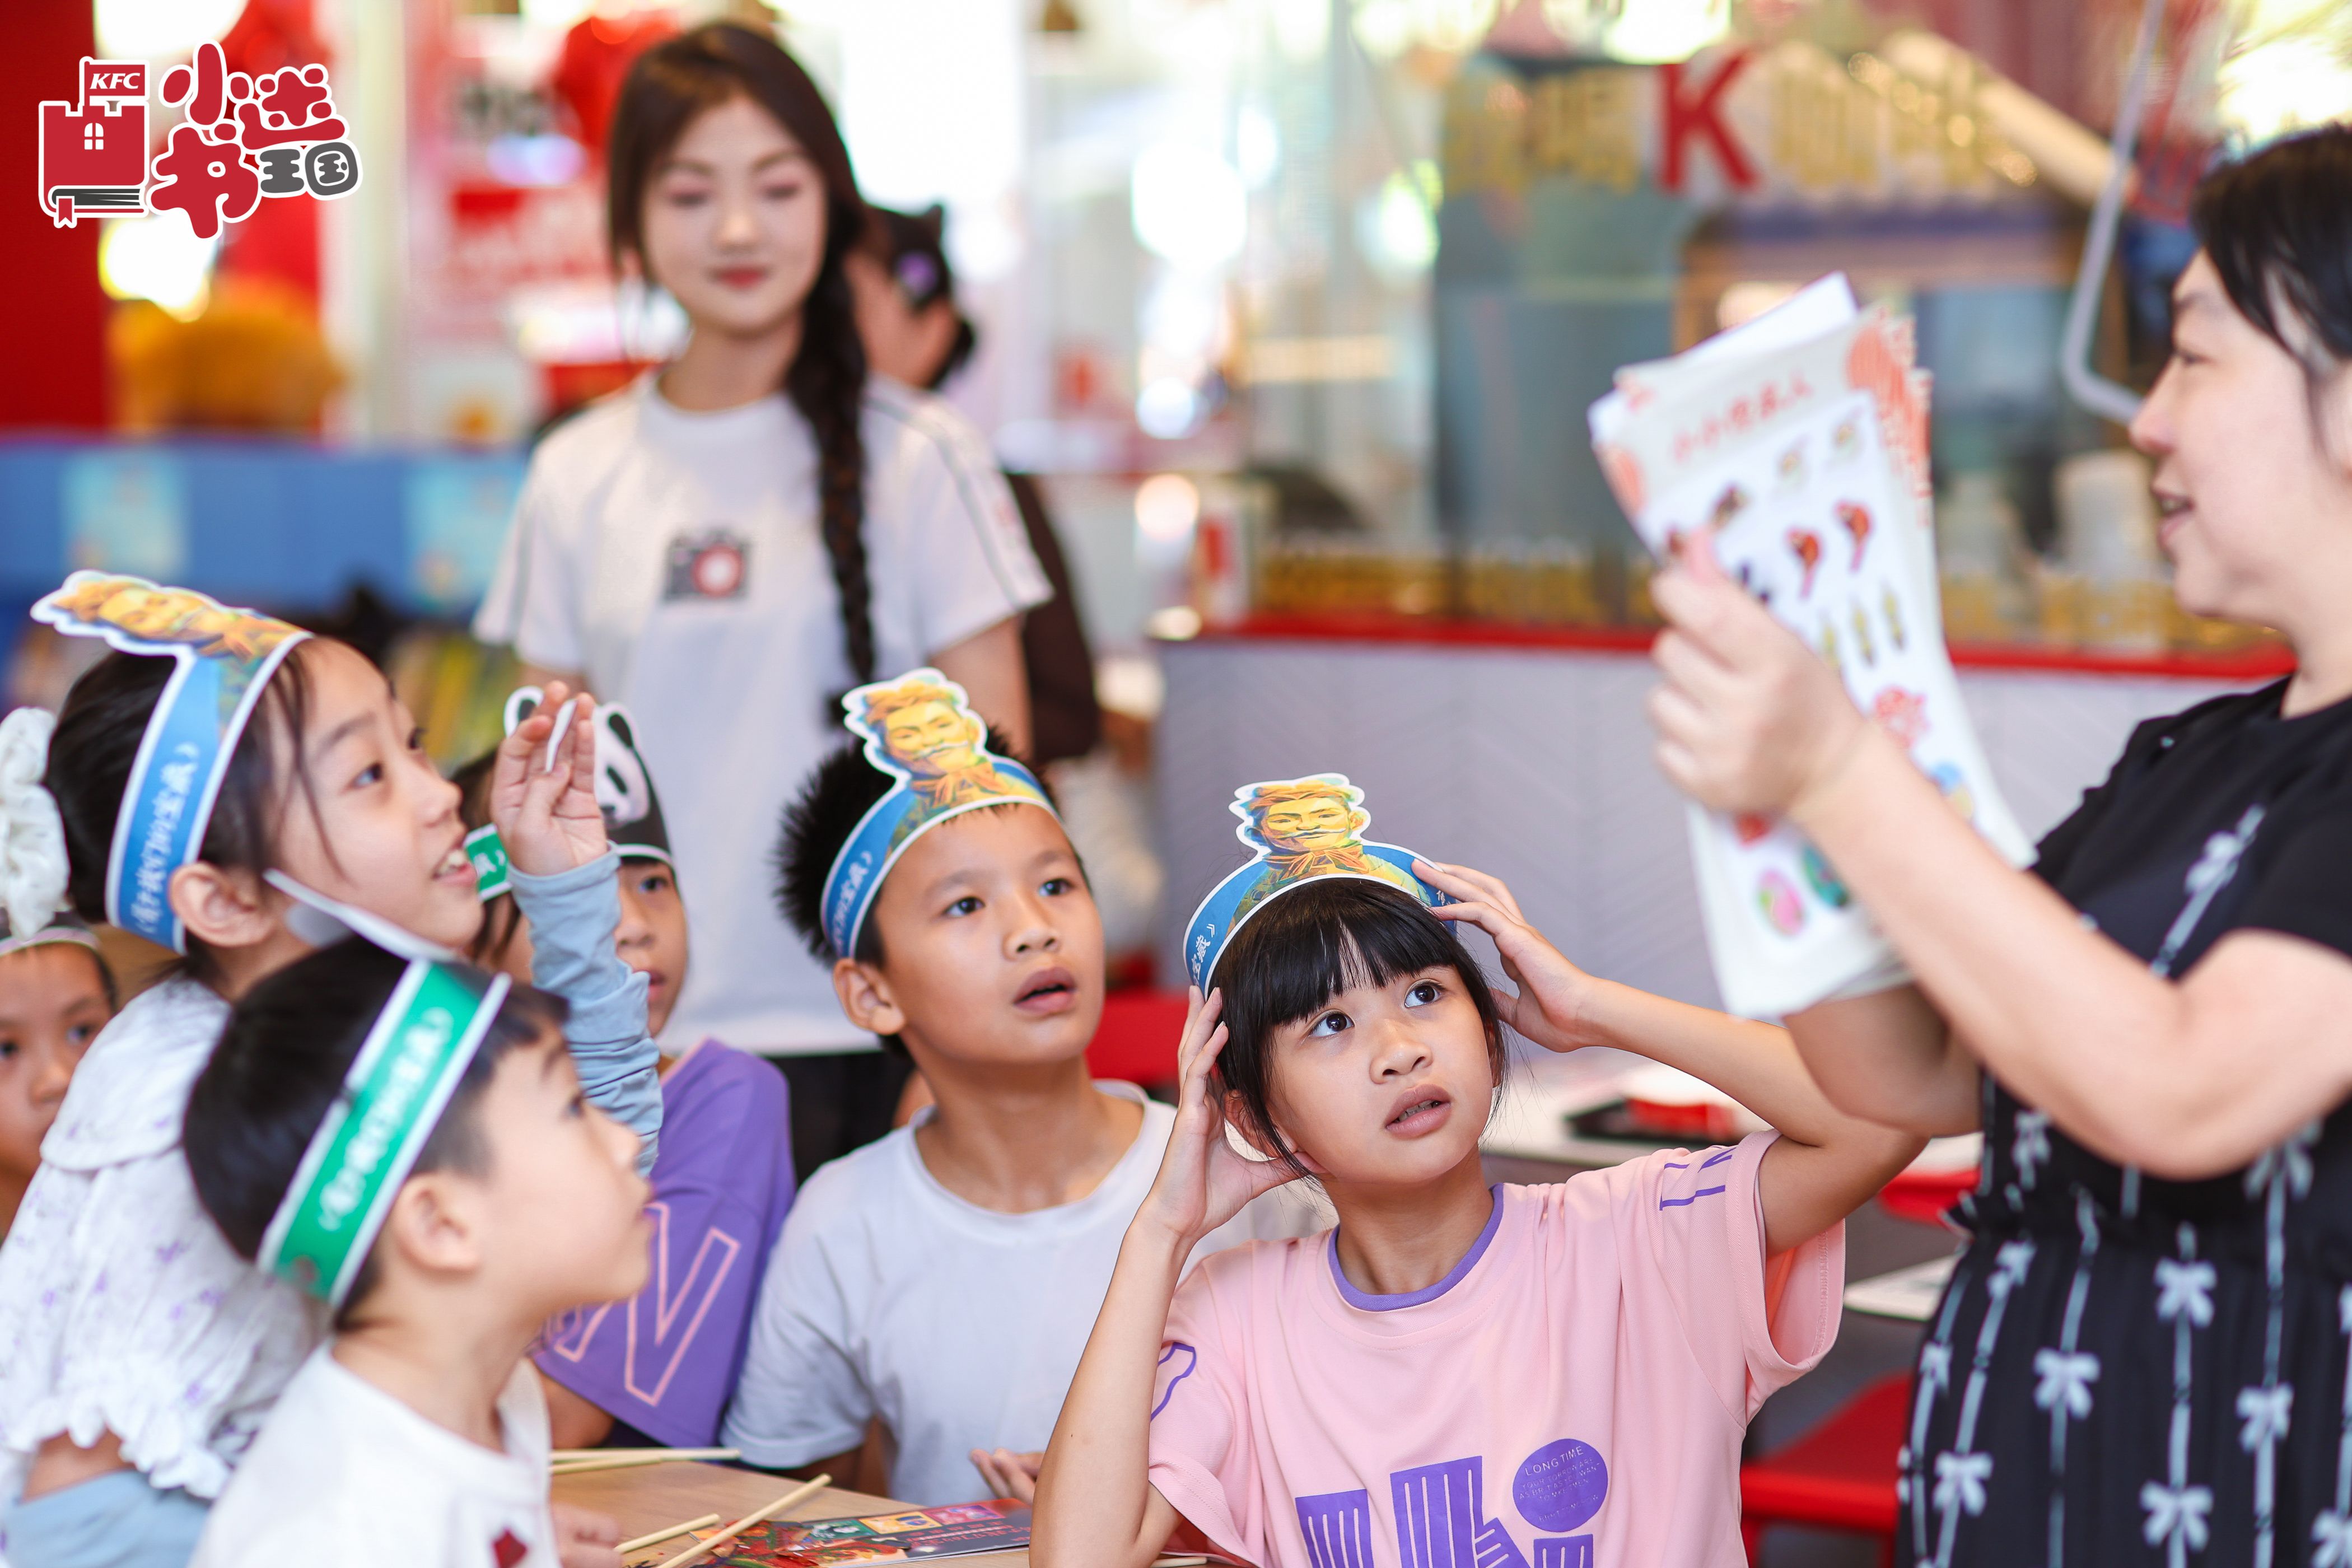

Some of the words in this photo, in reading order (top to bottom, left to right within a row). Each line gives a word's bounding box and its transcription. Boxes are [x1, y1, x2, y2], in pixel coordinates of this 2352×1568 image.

[1191, 923, 1215, 986] 宝藏》
[1525, 1458, 1559, 1476] LONG
[1560, 1445, 1584, 1463] TIME
